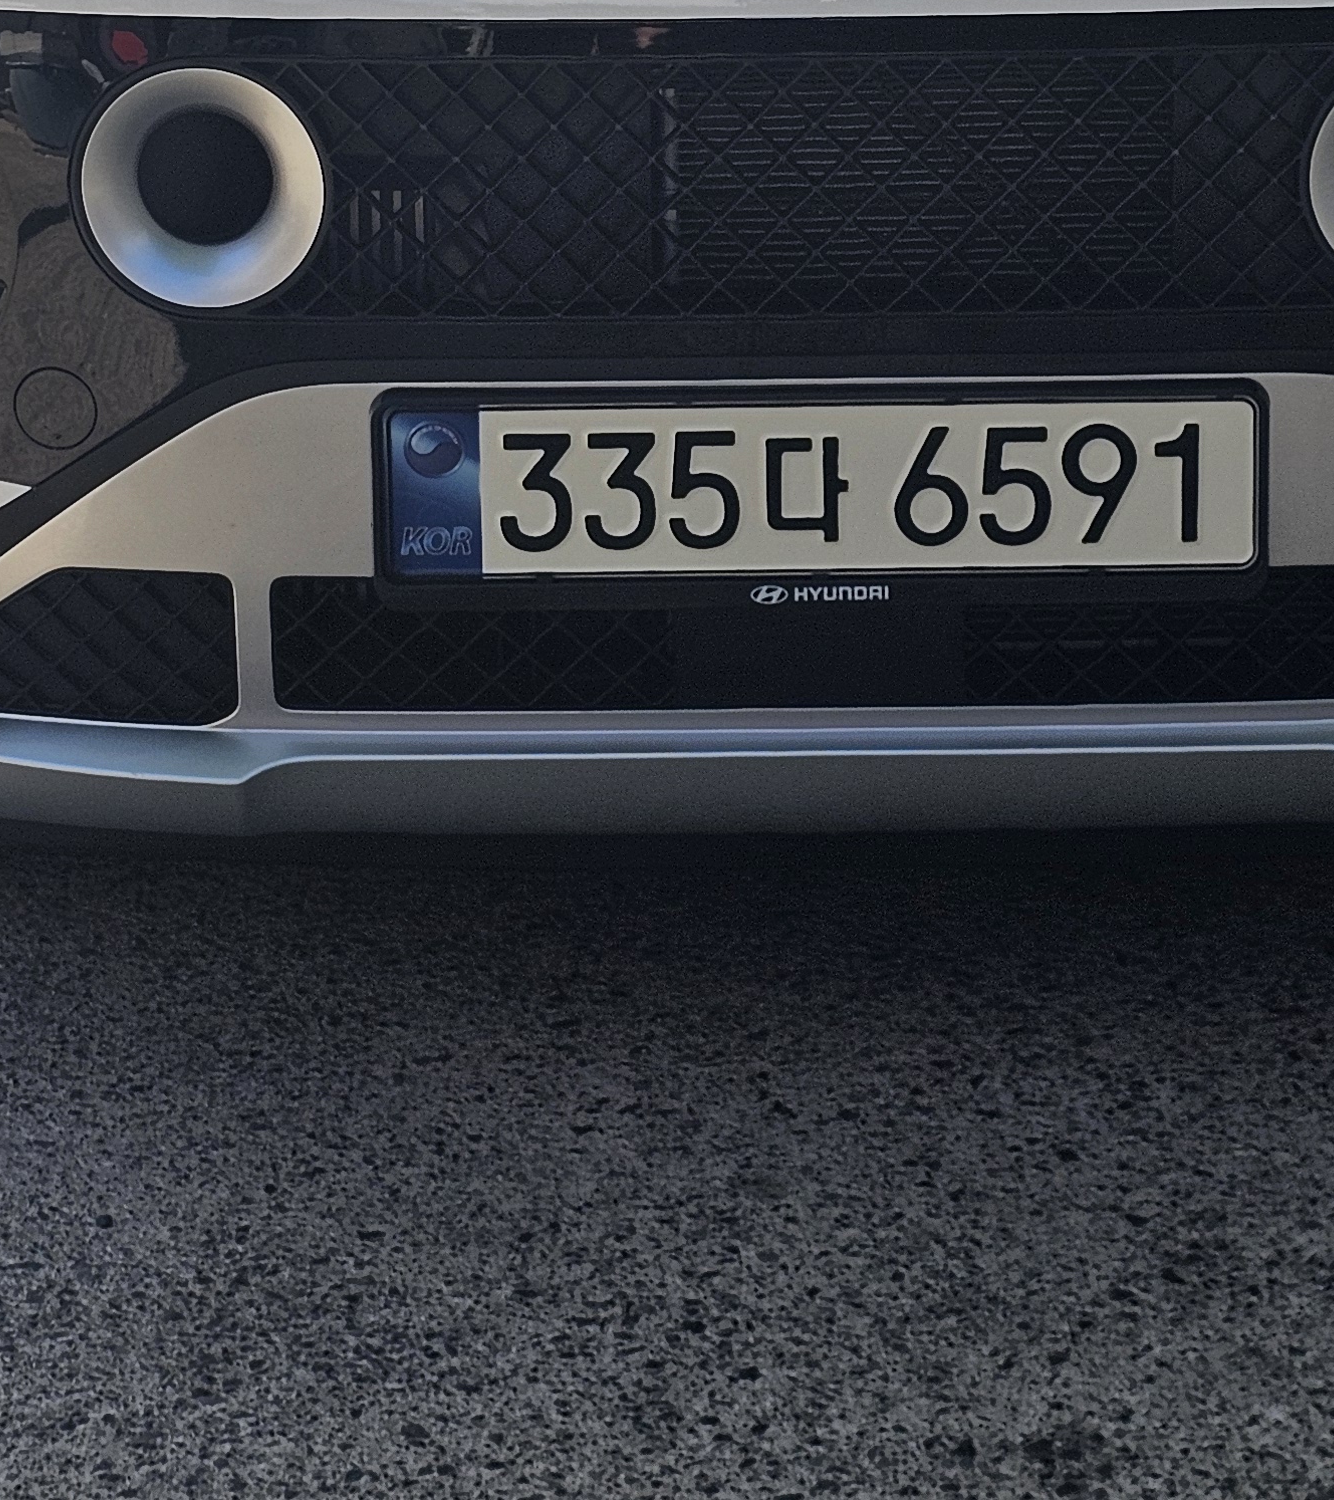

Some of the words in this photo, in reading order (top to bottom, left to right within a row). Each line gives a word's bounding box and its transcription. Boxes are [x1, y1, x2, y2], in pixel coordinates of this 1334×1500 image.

[499, 430, 849, 553] 335다
[894, 423, 1201, 548] 6591
[401, 526, 473, 556] KOR
[794, 585, 889, 601] HYUNDAI
